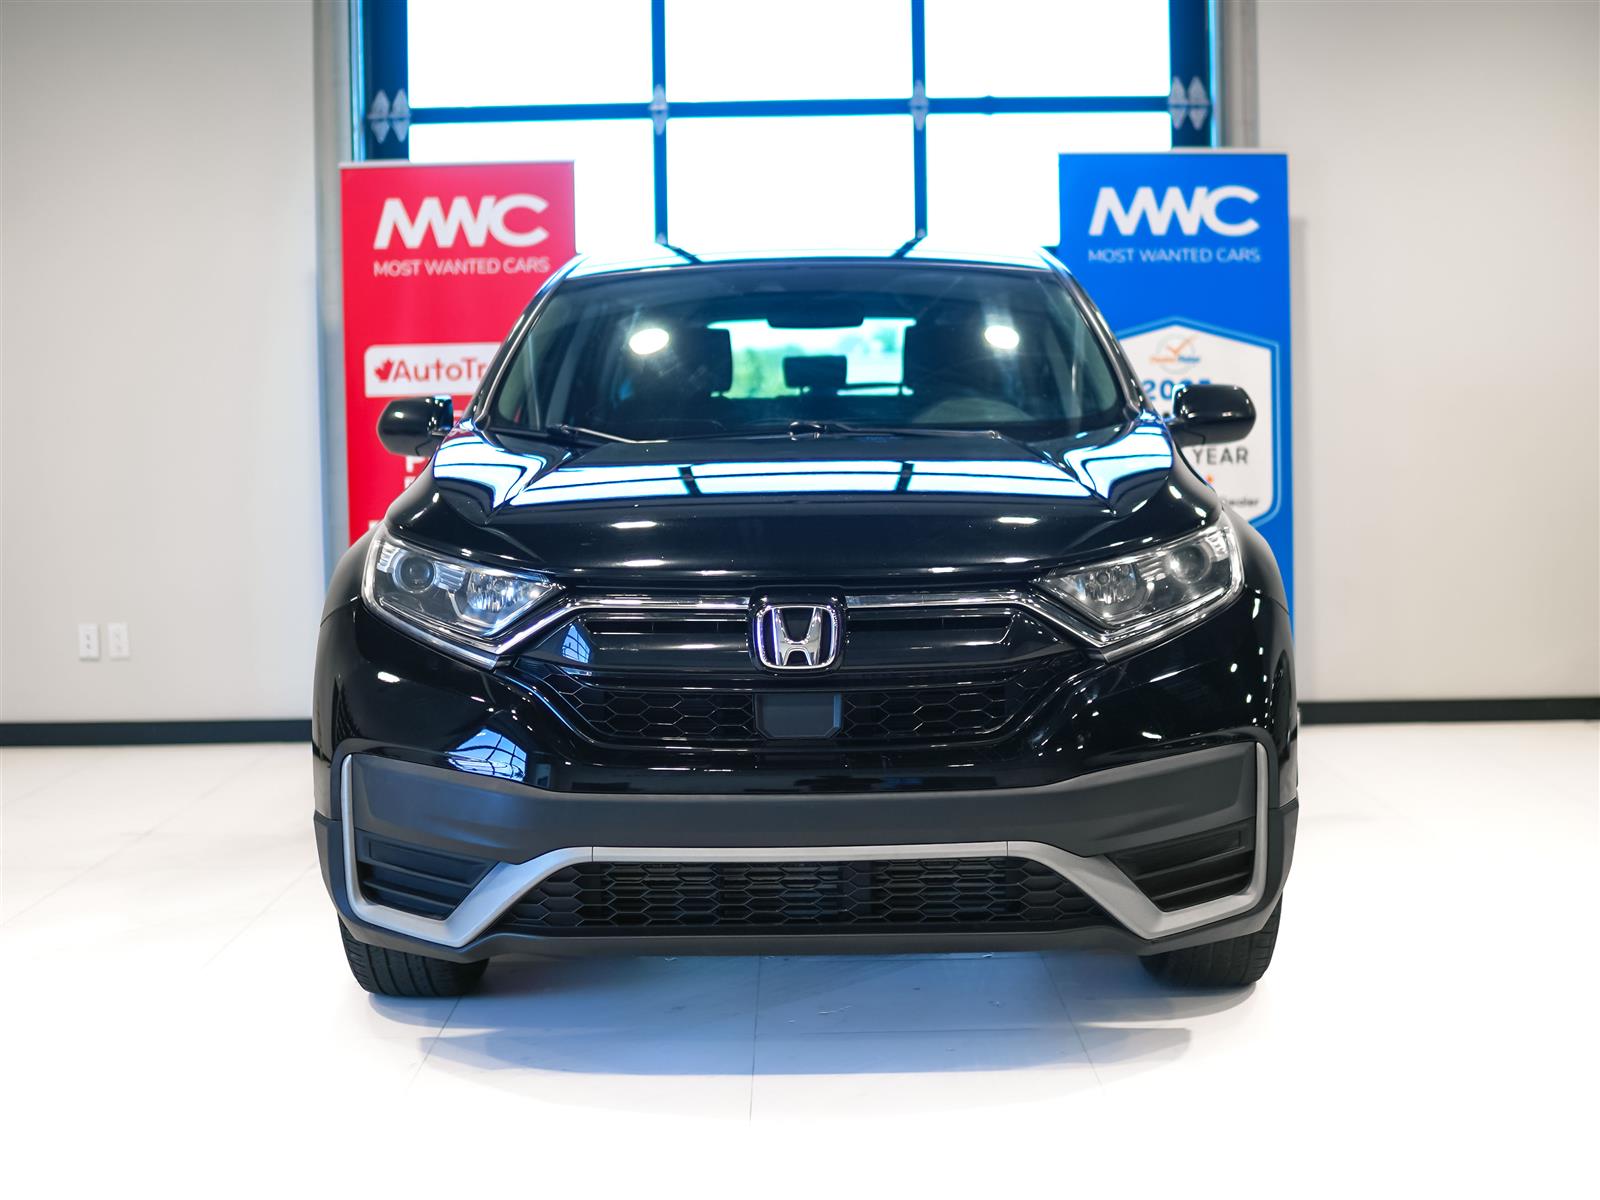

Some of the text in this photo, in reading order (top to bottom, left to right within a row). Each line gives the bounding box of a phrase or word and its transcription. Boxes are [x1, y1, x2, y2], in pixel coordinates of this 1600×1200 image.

[373, 193, 549, 250] MWC
[1088, 185, 1260, 237] MWC
[373, 255, 550, 277] MOST WANTED CARS
[1088, 247, 1261, 263] MOST WANTED CARS
[1142, 378, 1212, 401] 20
[1193, 446, 1249, 465] YEAR
